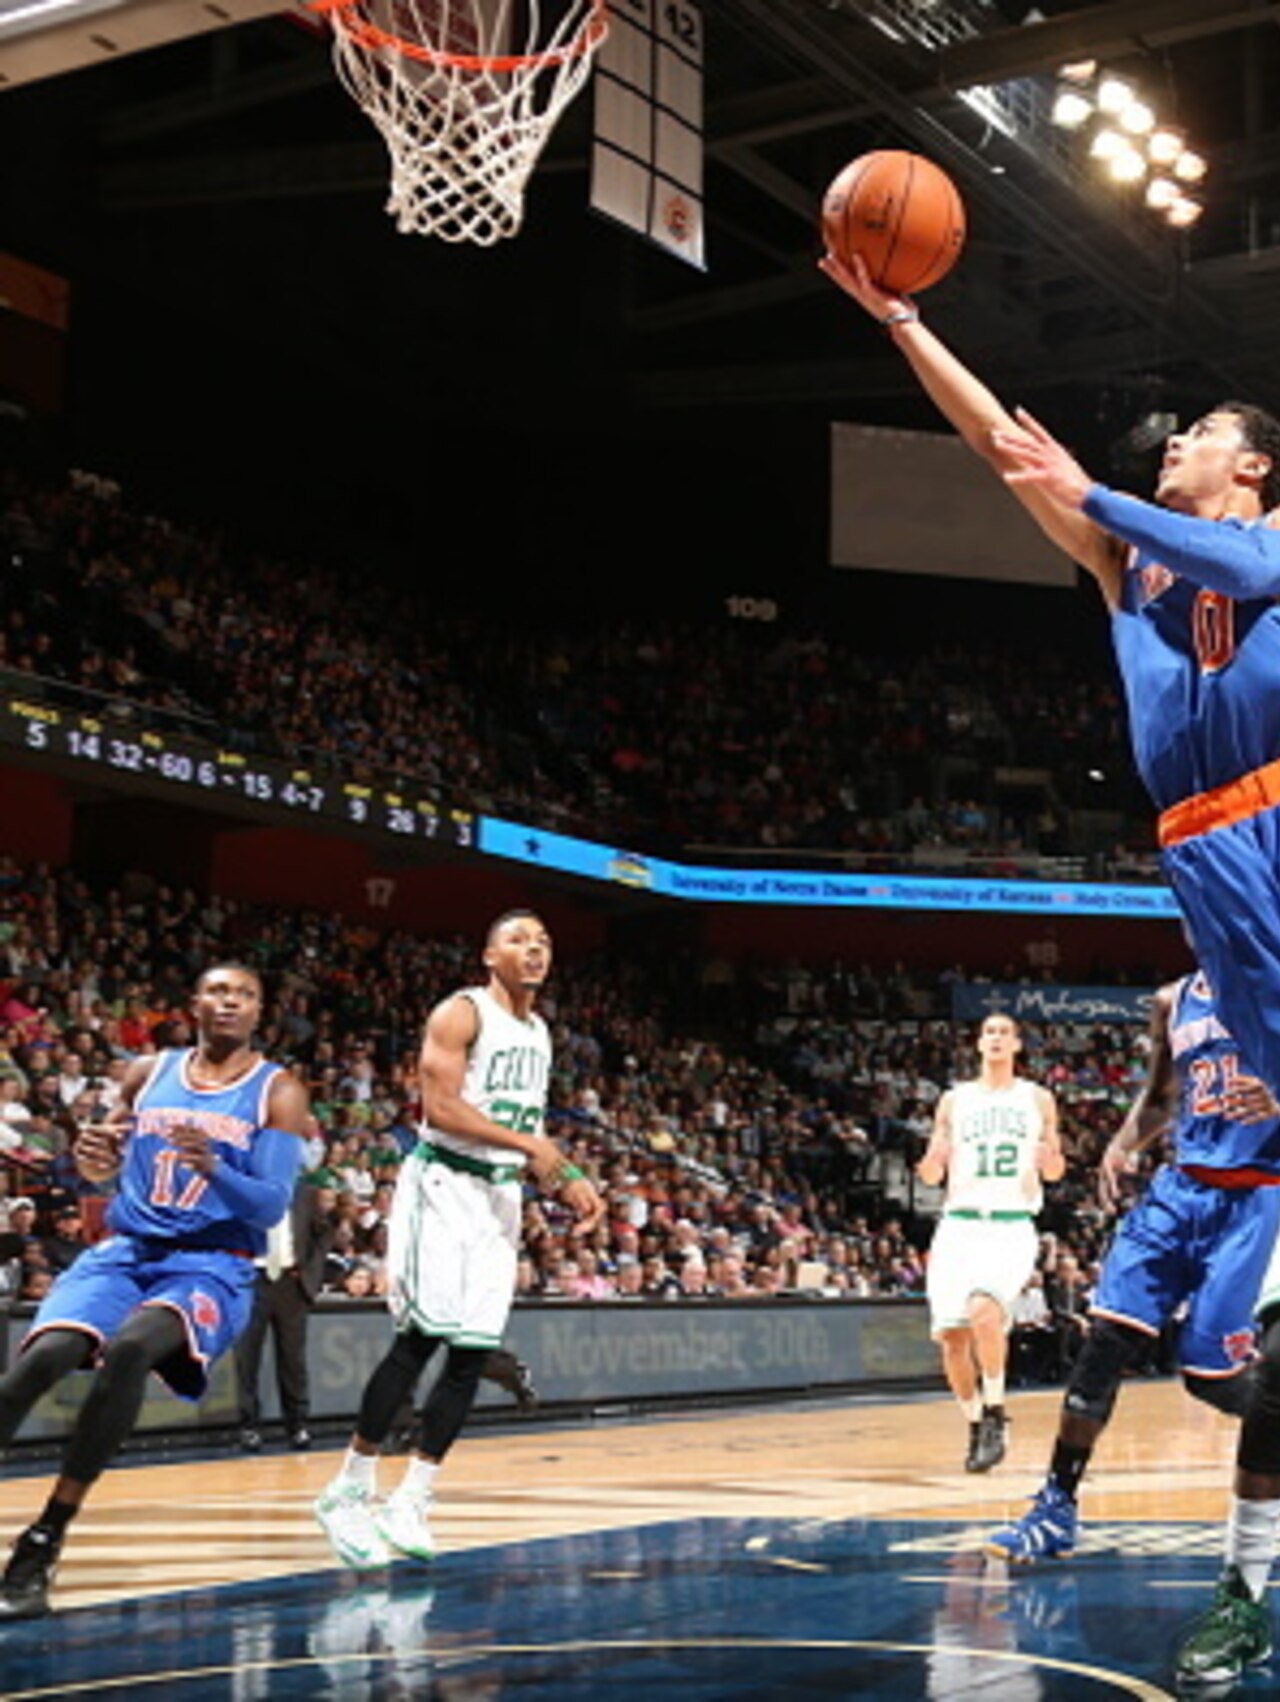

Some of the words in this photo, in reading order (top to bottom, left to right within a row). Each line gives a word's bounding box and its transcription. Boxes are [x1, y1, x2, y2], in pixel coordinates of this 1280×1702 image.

[1193, 587, 1234, 674] 0
[26, 720, 48, 749] 5
[67, 730, 100, 760] 14
[365, 877, 395, 908] 17
[960, 1106, 1027, 1143] CELTICS
[975, 1142, 1018, 1178] 12
[542, 1318, 747, 1378] November
[752, 1313, 830, 1367] 30th
